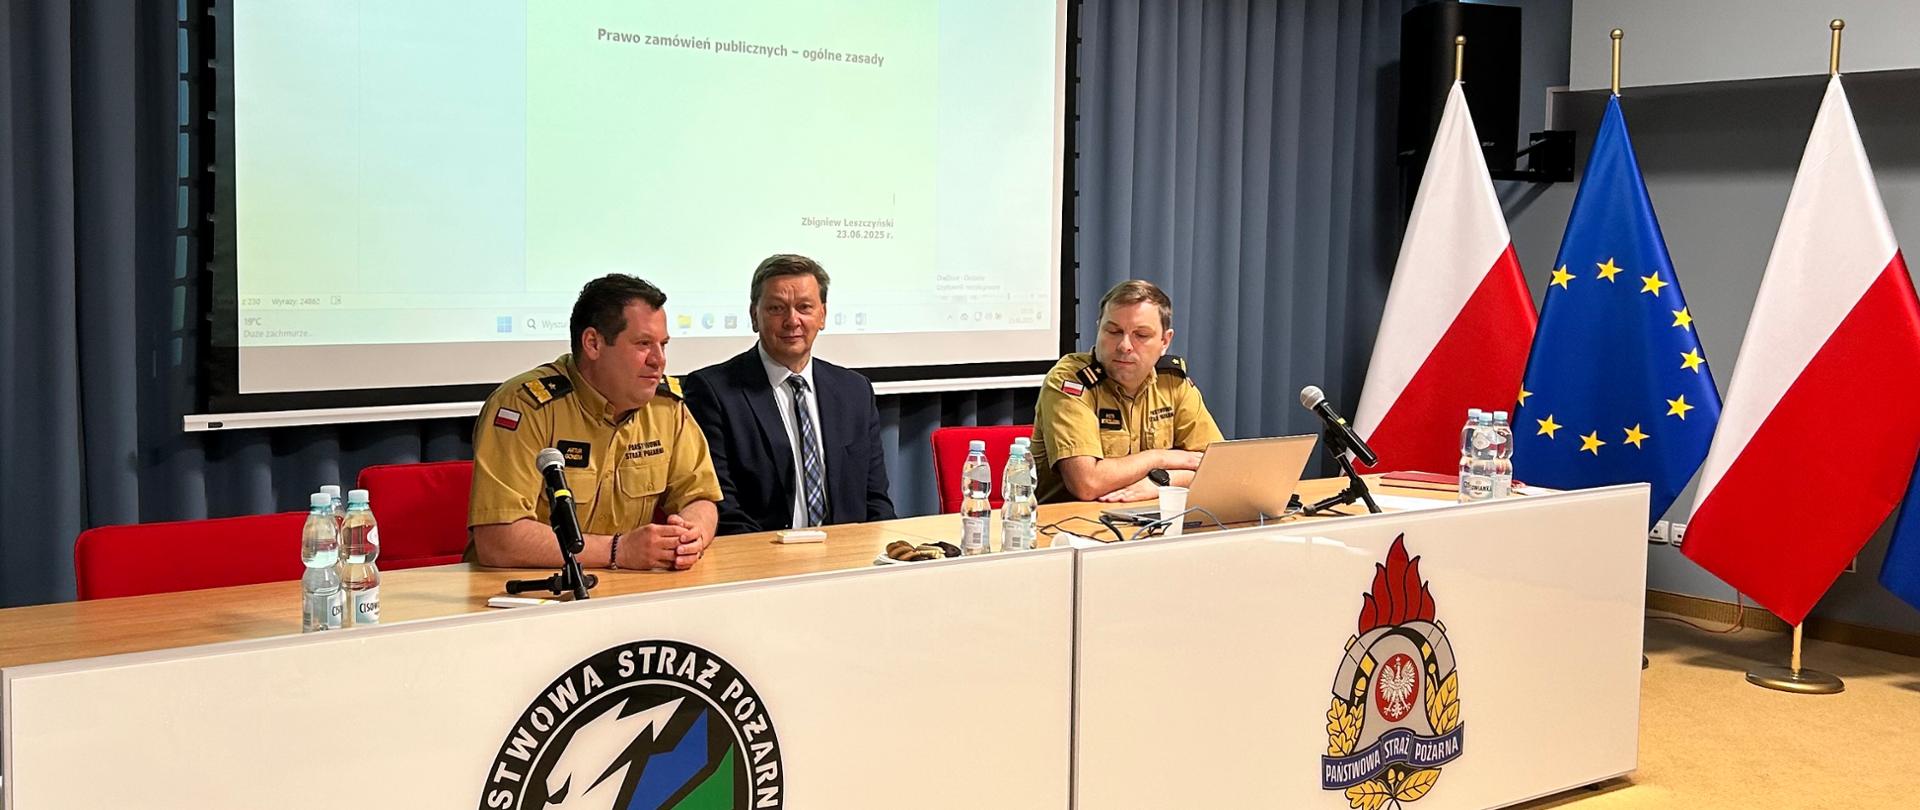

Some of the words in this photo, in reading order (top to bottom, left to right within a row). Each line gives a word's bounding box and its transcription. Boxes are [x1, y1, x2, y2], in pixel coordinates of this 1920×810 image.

[597, 28, 641, 44] Prawo
[644, 33, 711, 50] zamówień
[715, 39, 788, 58] publicznych
[802, 48, 842, 62] ogólne
[845, 51, 884, 67] zasady
[801, 217, 841, 229] Zbigniew
[844, 218, 894, 229] Leszczyński
[836, 230, 885, 240] 23.06.2025
[617, 646, 722, 690] STRAŻ
[1325, 750, 1381, 783] PAŃSTWOWA
[1384, 734, 1411, 759] STRAŻ
[1414, 736, 1459, 762] POŻARNA
